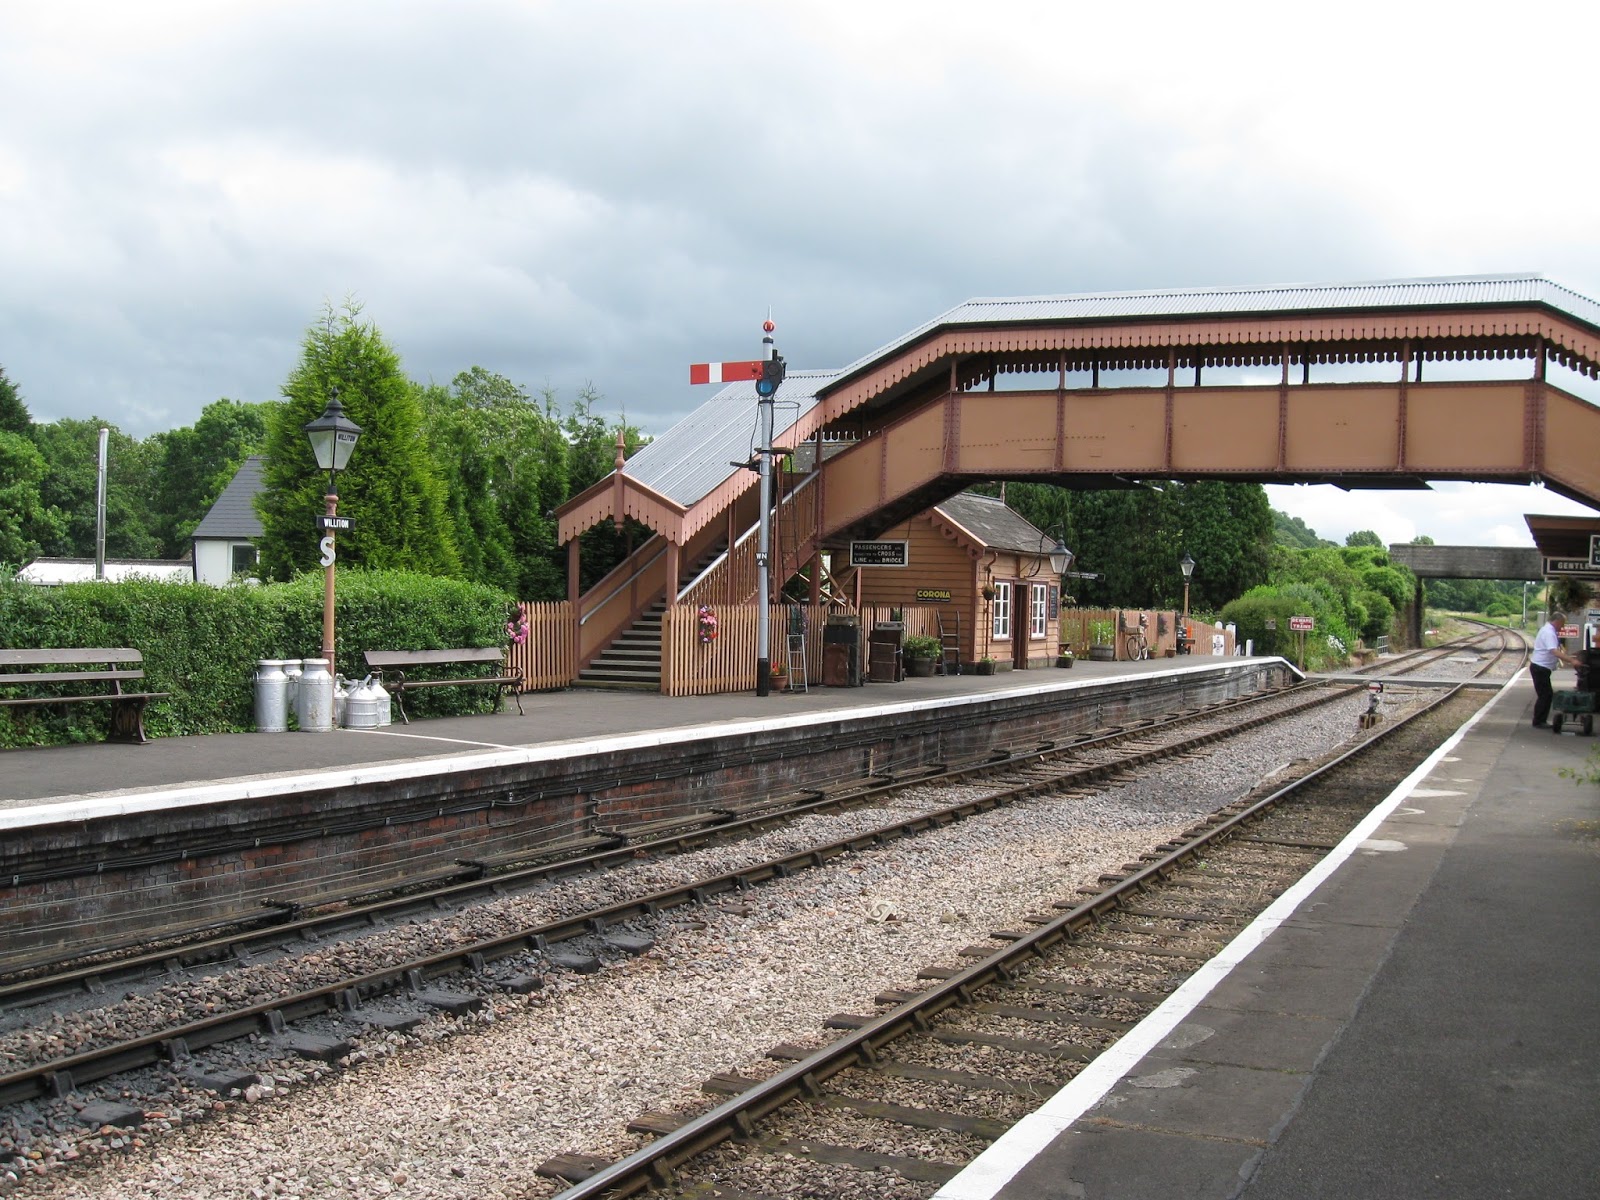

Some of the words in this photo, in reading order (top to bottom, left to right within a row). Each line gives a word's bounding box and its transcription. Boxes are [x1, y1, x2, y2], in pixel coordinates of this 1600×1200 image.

[323, 518, 349, 528] WILLITON
[320, 536, 336, 567] S
[917, 590, 951, 598] CORONA
